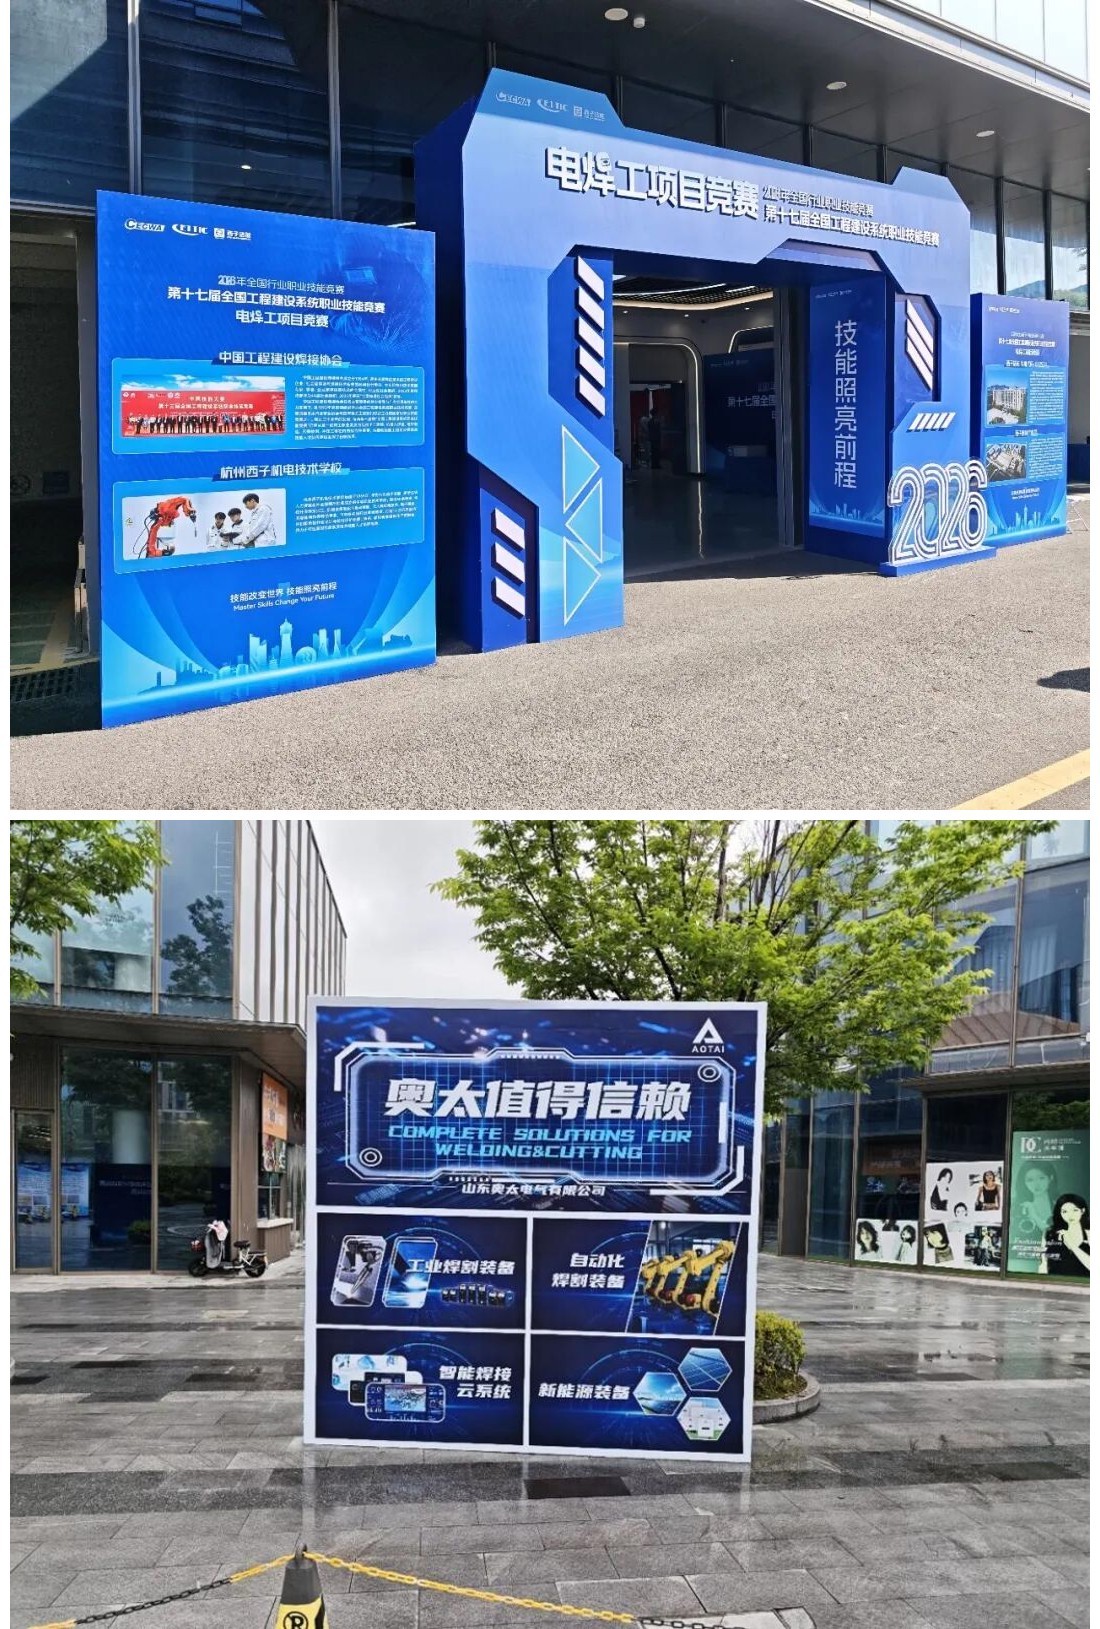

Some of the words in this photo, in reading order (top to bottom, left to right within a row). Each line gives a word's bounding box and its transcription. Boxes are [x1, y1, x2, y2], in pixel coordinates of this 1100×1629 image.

[545, 147, 759, 219] 电焊工项目竞赛
[764, 204, 940, 248] 第十七届全国工程建设系统职业技能竞赛
[167, 286, 386, 313] 第十七届全国工程建设系统职业技能竞赛
[235, 309, 329, 328] 电焊工项目竞赛
[219, 351, 342, 366] 中国工程建设焊接协会
[834, 320, 857, 489] 技能照亮前程
[220, 462, 342, 479] 杭州西子机电技术学校
[887, 457, 987, 564] 2026
[230, 588, 283, 603] 技能改变世界
[233, 603, 256, 611] Master
[275, 598, 299, 606] Change
[692, 1045, 724, 1053] AOTAI
[383, 1078, 691, 1120] 奥太值得信赖
[388, 1125, 502, 1140] COMPLETE
[514, 1128, 635, 1142] SOLUTIONS
[647, 1130, 692, 1143] FOR
[435, 1143, 642, 1159] WELDING&CUTTING
[461, 1183, 606, 1196] 山东奥太电气有限公司
[406, 1259, 515, 1275] 工业焊割装备
[570, 1253, 625, 1268] 自动化
[551, 1273, 625, 1288] 焊割装备
[439, 1365, 512, 1382] 智能焊接
[457, 1383, 512, 1399] 云系统
[538, 1383, 630, 1400] 新能源装备
